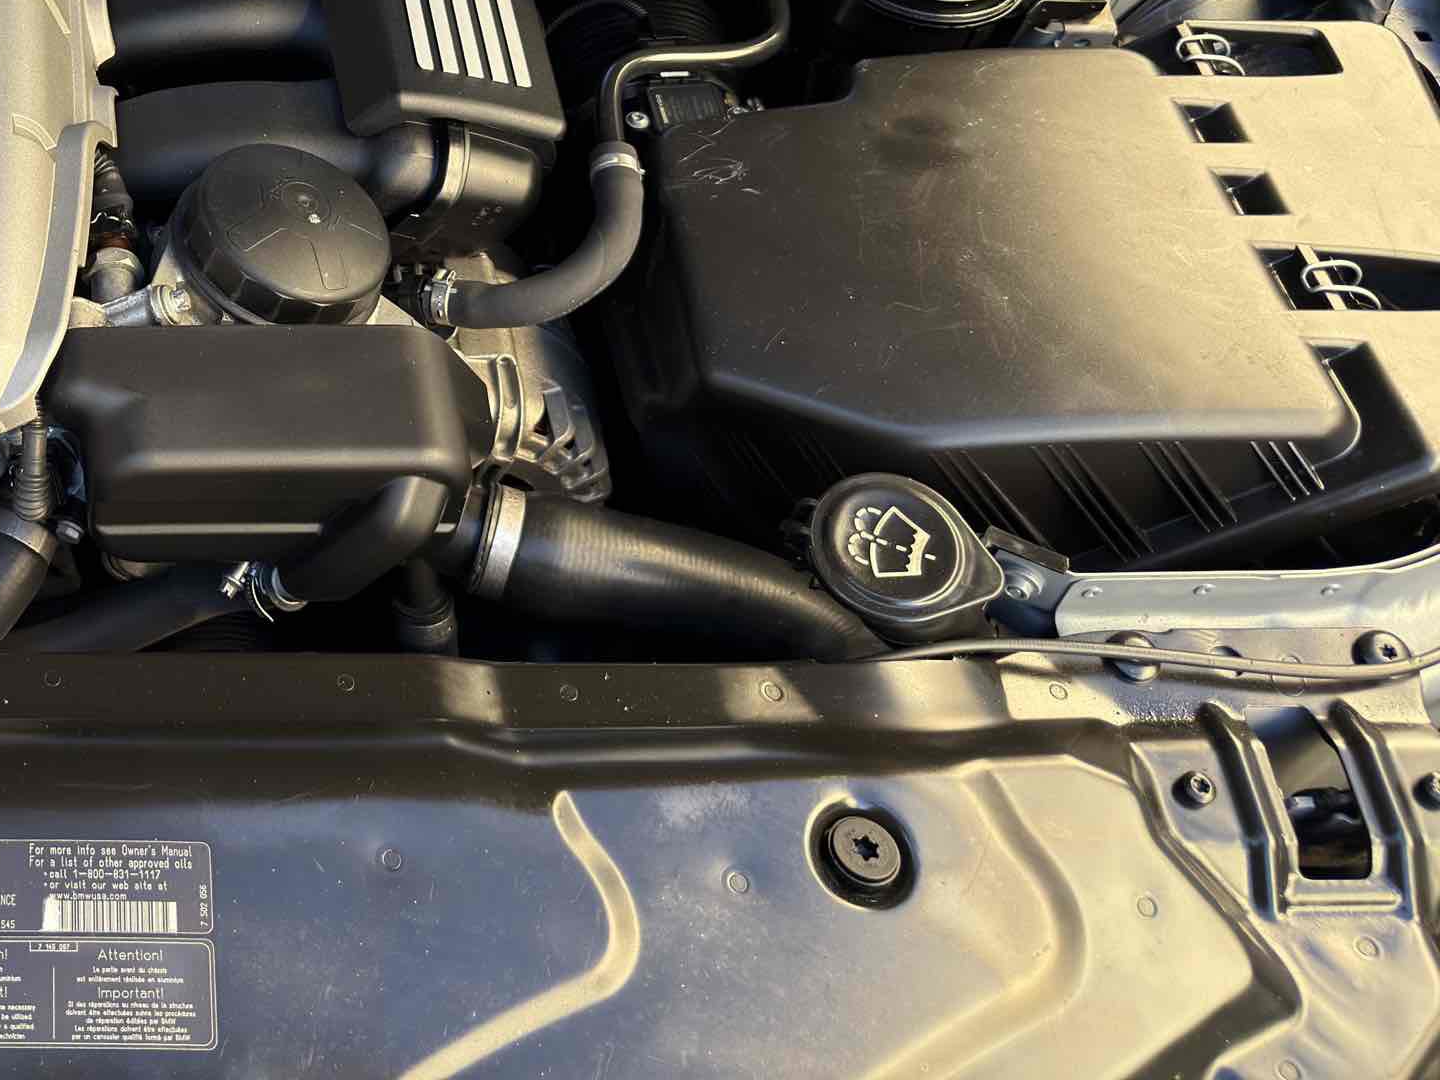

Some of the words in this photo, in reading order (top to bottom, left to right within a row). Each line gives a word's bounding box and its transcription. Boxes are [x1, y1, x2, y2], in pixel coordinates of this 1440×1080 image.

[29, 844, 44, 856] For
[50, 847, 71, 855] more
[78, 845, 95, 855] info
[122, 844, 156, 856] Owner's
[162, 846, 192, 856] Manual
[29, 857, 44, 867] For
[62, 858, 77, 867] list
[83, 858, 92, 867] of
[99, 858, 123, 867] other
[129, 858, 169, 869] approved
[49, 870, 67, 878] call
[98, 949, 163, 961] Attention!
[98, 987, 164, 1000] Important!
